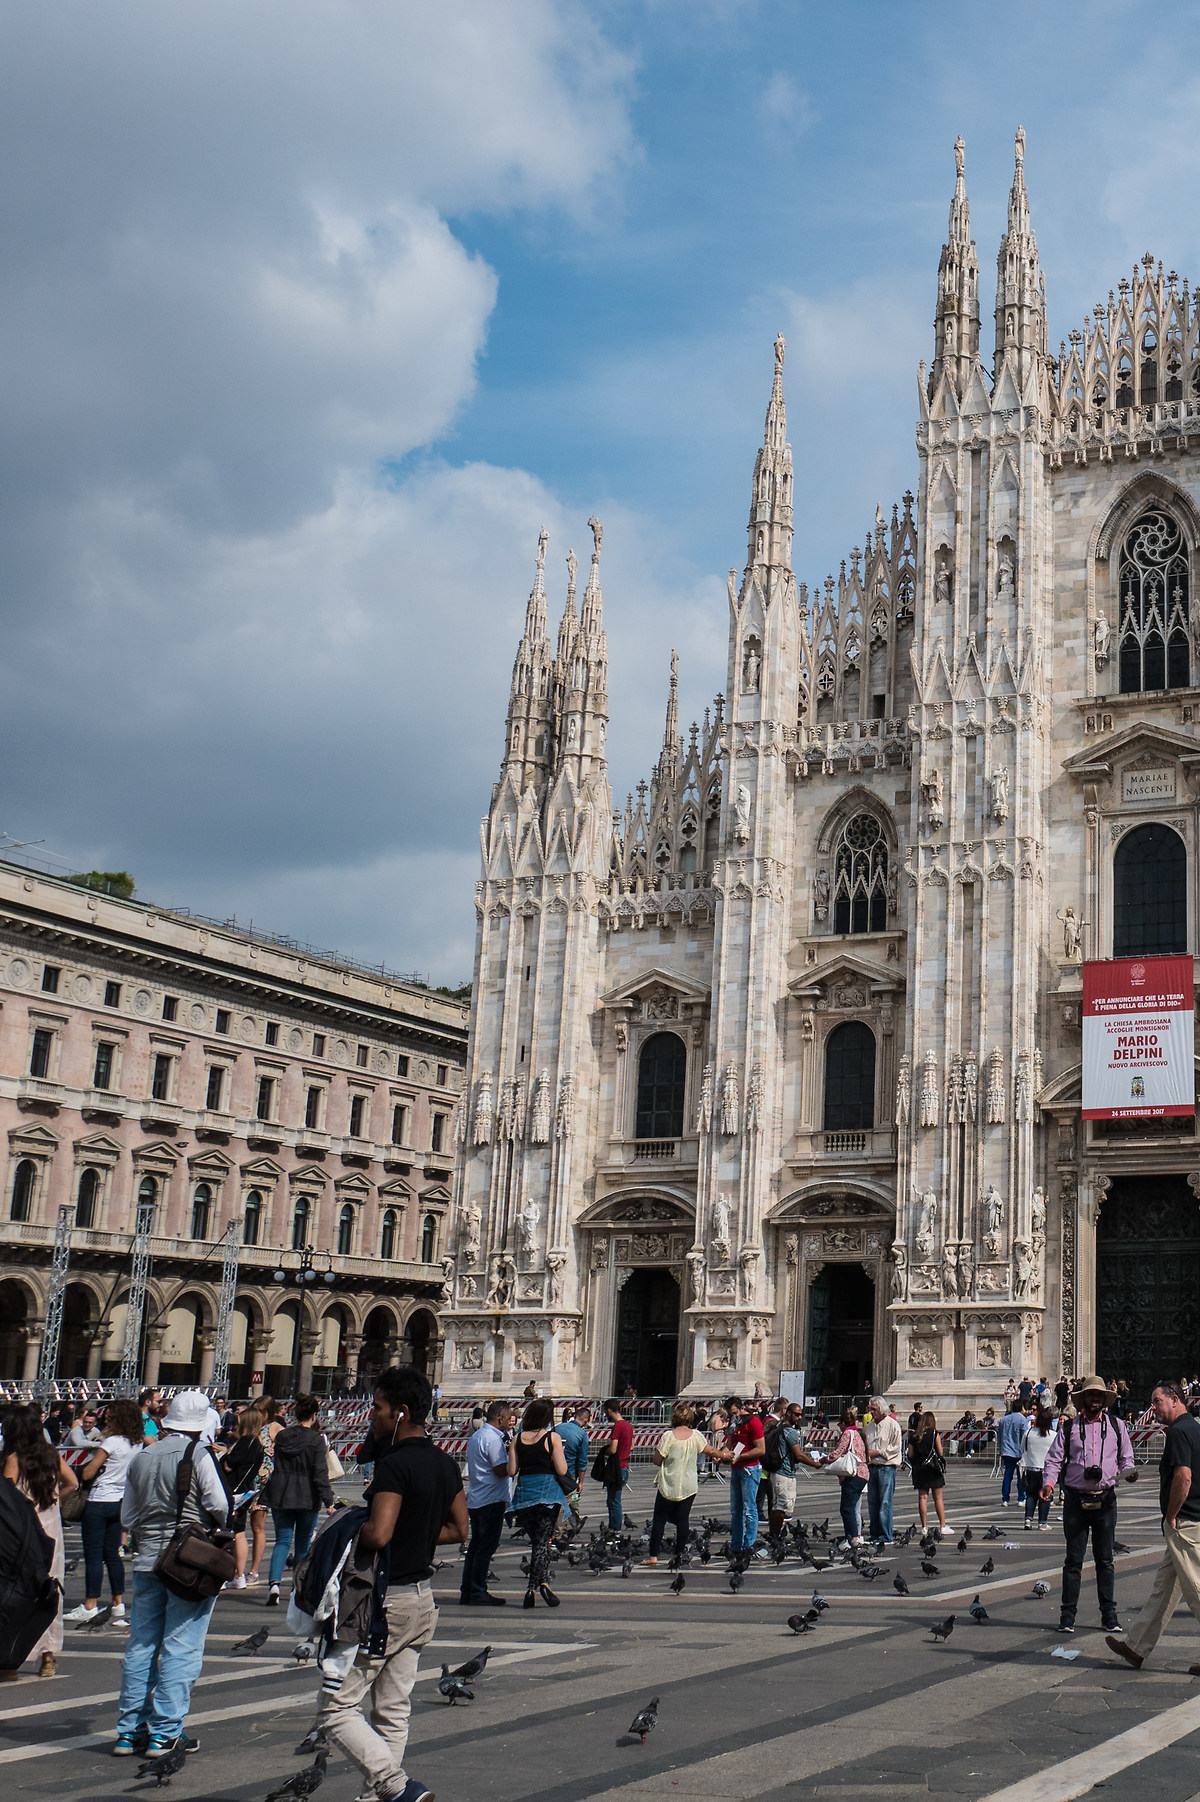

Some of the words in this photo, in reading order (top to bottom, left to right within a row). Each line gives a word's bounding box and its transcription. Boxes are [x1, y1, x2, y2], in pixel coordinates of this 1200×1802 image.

[1130, 773, 1169, 783] MARIAE
[1126, 785, 1173, 796] NASCENTI
[1107, 996, 1143, 1004] ANNUNCIARE
[1134, 1018, 1171, 1026] AMBROSIANA
[1117, 1035, 1158, 1047] MARIO
[1113, 1047, 1163, 1061] DELPINI
[1129, 1060, 1168, 1068] ARCIVESCOVO
[1119, 1109, 1151, 1117] SETTEMBRE
